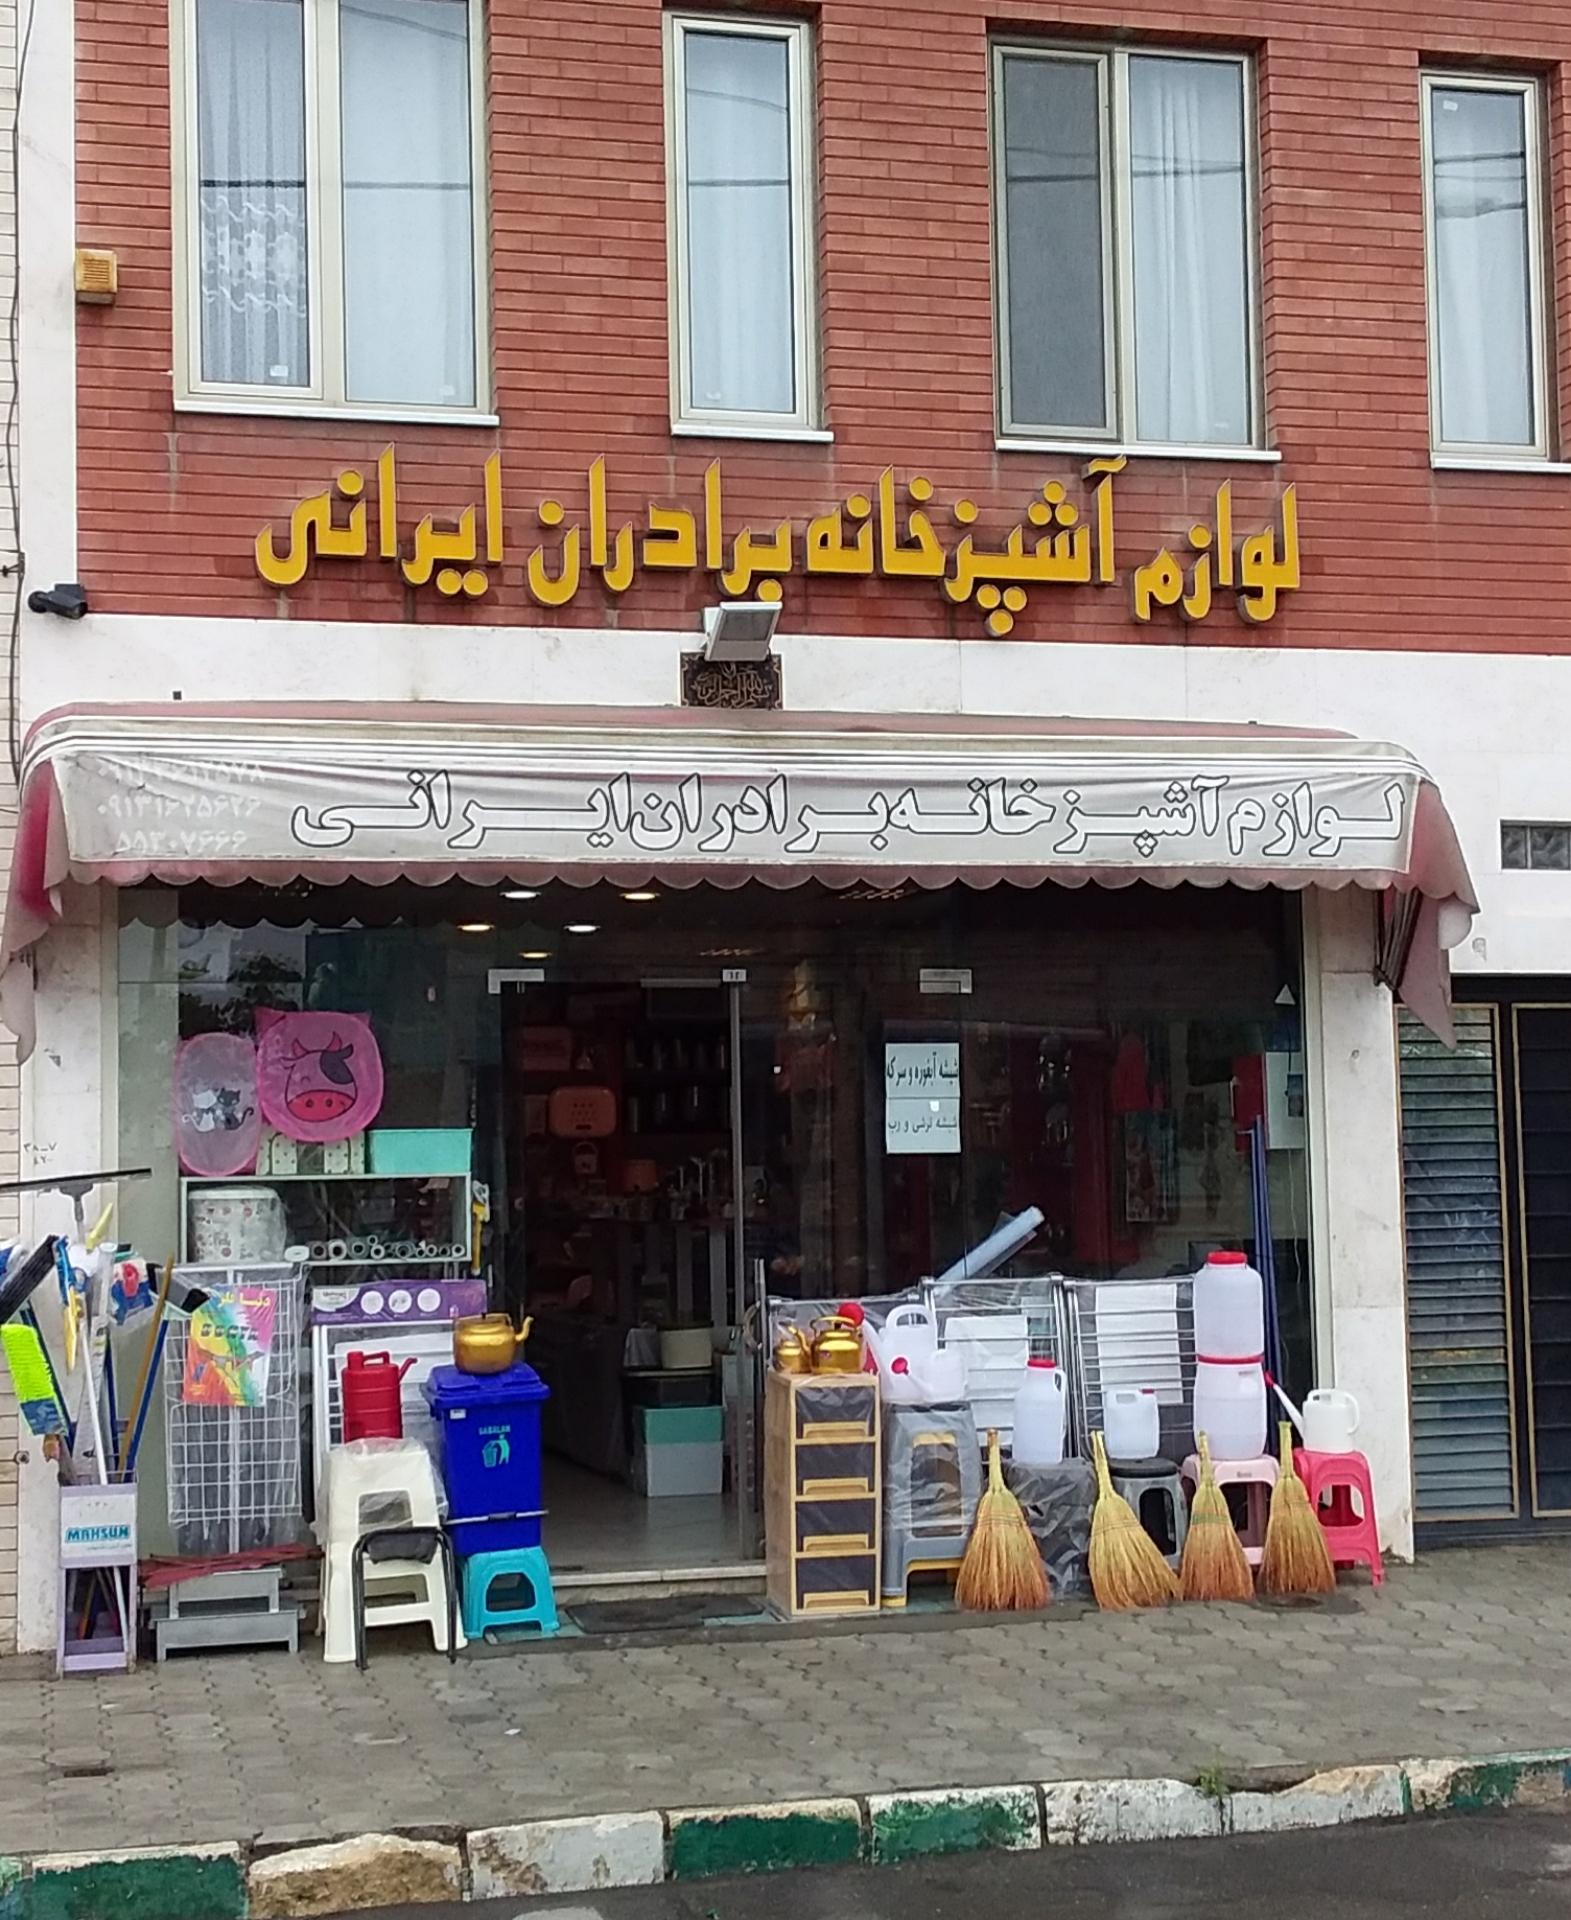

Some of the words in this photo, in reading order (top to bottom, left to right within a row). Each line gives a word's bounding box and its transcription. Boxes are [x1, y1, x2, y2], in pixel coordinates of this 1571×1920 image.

[254, 441, 503, 598] ایرانی
[527, 455, 794, 605] برادران
[806, 454, 1128, 636] آشپزخانه
[1131, 479, 1301, 623] لوازم
[291, 769, 631, 849] ایرانی
[629, 772, 889, 853] برادران
[886, 774, 1231, 857] آشپزخانه
[1227, 781, 1405, 857] لوازم
